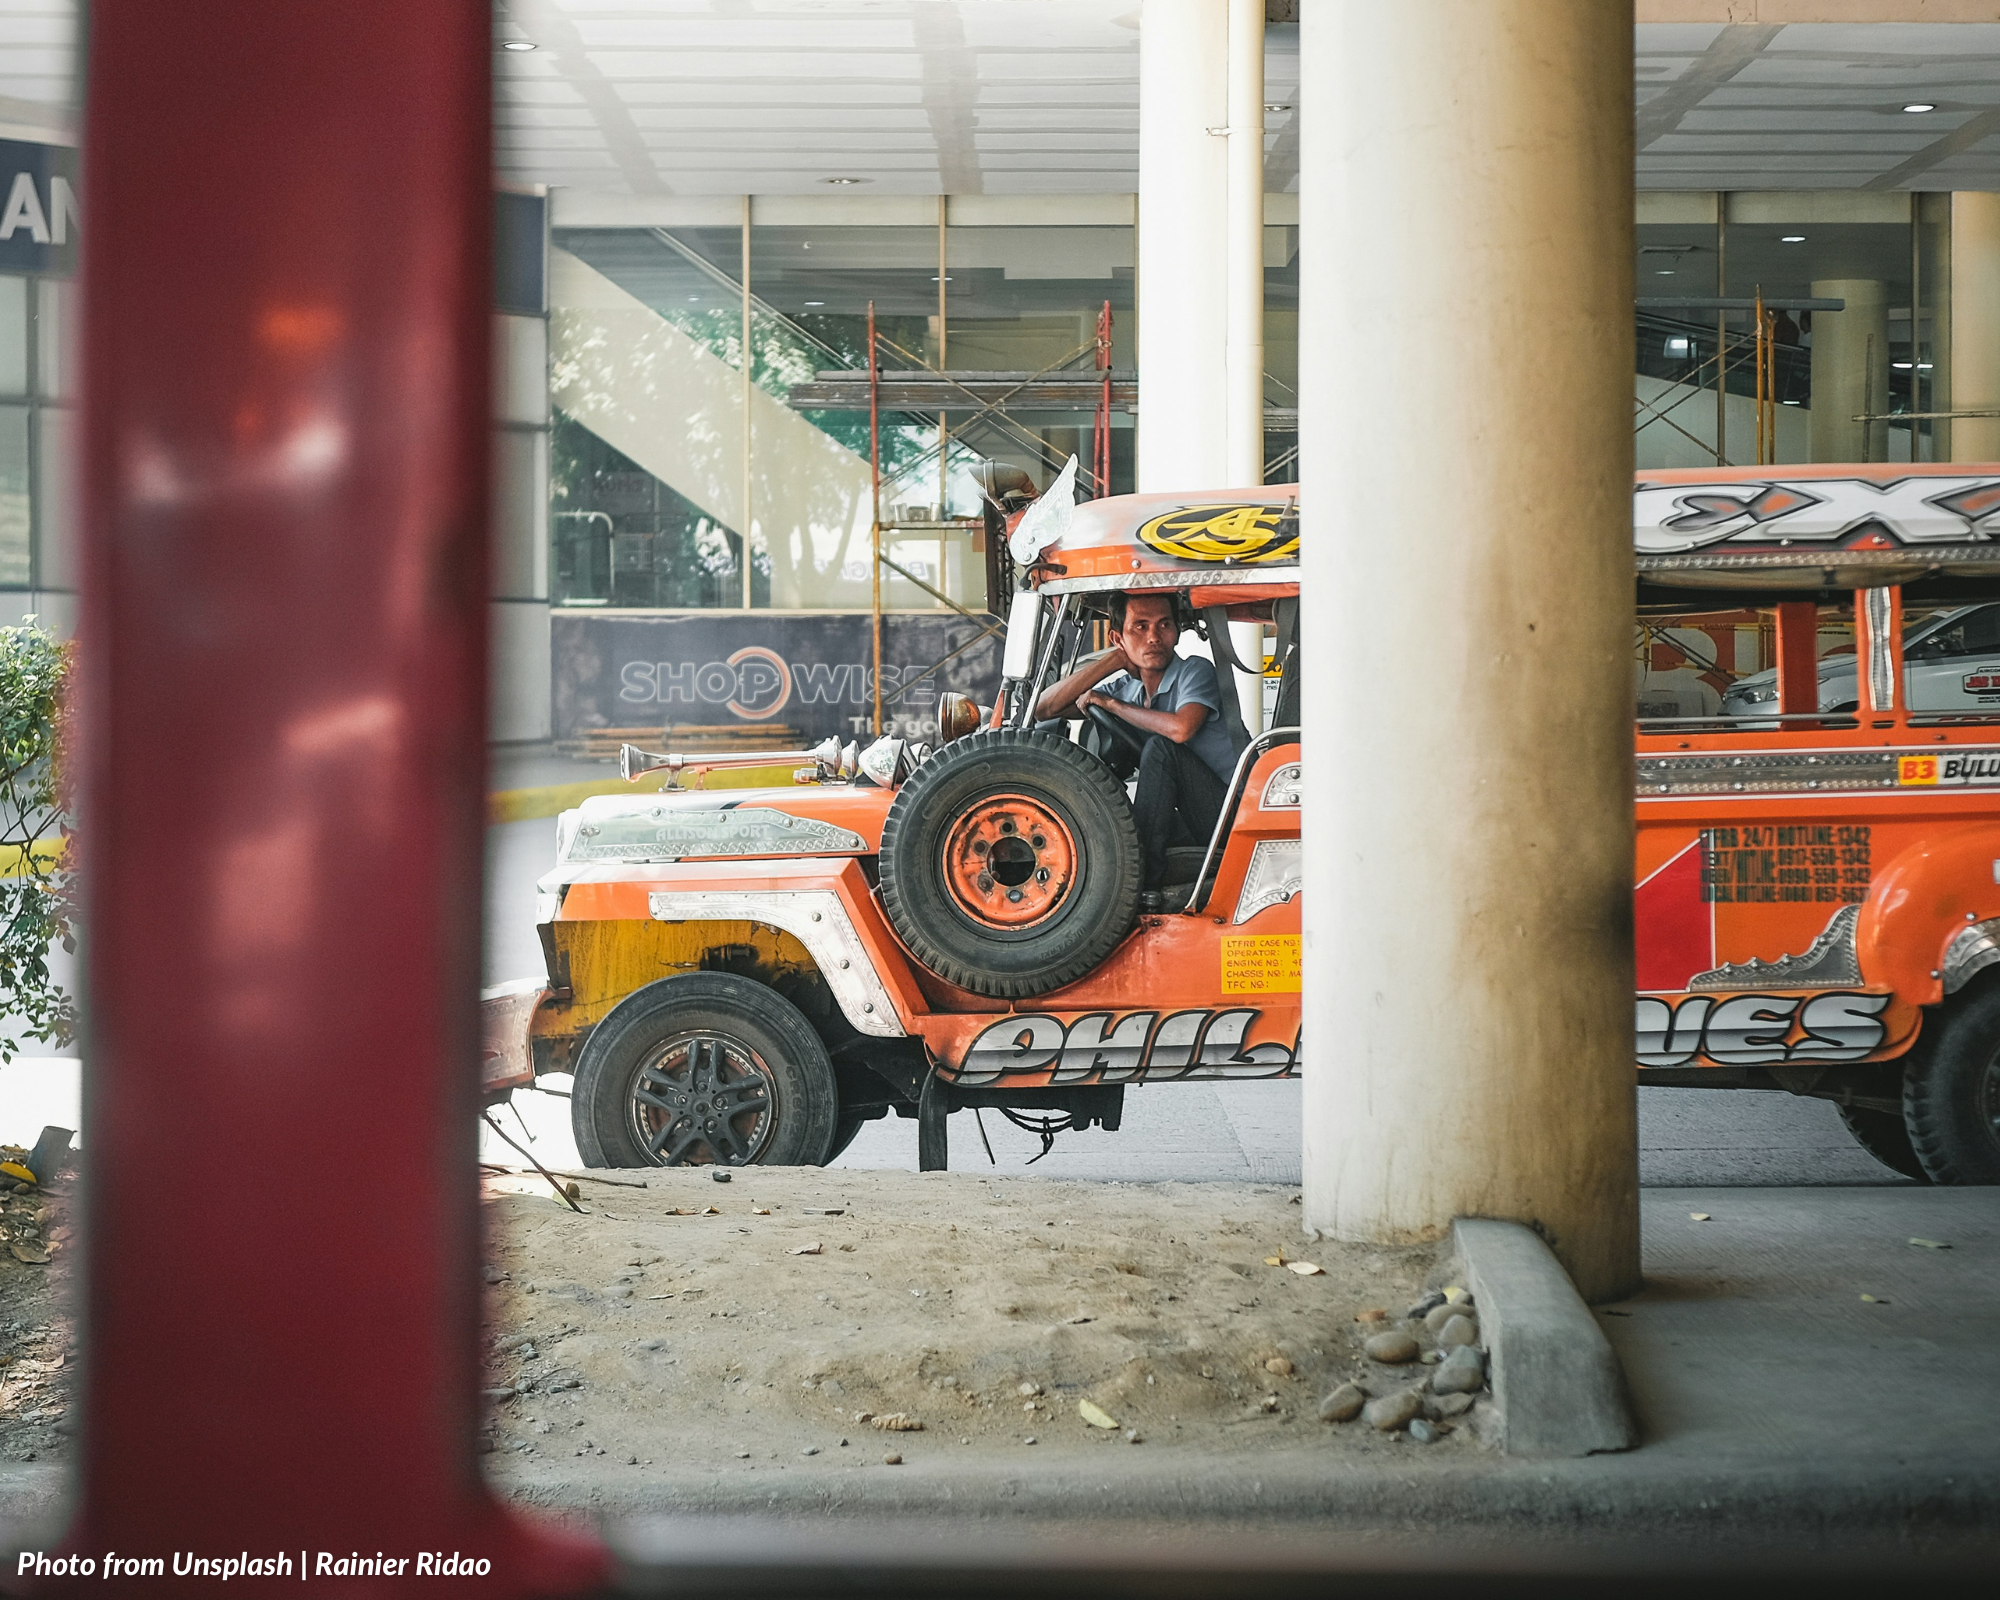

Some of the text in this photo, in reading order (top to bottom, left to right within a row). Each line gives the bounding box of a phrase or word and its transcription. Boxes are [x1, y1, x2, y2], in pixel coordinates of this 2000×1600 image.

[620, 655, 937, 708] SHOPWISE
[1903, 760, 1935, 780] B3
[655, 824, 773, 842] ALLISON SPORT
[1743, 827, 1775, 847] 24/7
[1227, 940, 1256, 948] LTFRB
[1260, 939, 1280, 947] CASE
[1227, 959, 1263, 967] ENGINE
[1226, 970, 1264, 978] CHASSIS
[1227, 980, 1246, 989] TFC
[953, 1008, 1302, 1088] PHIL
